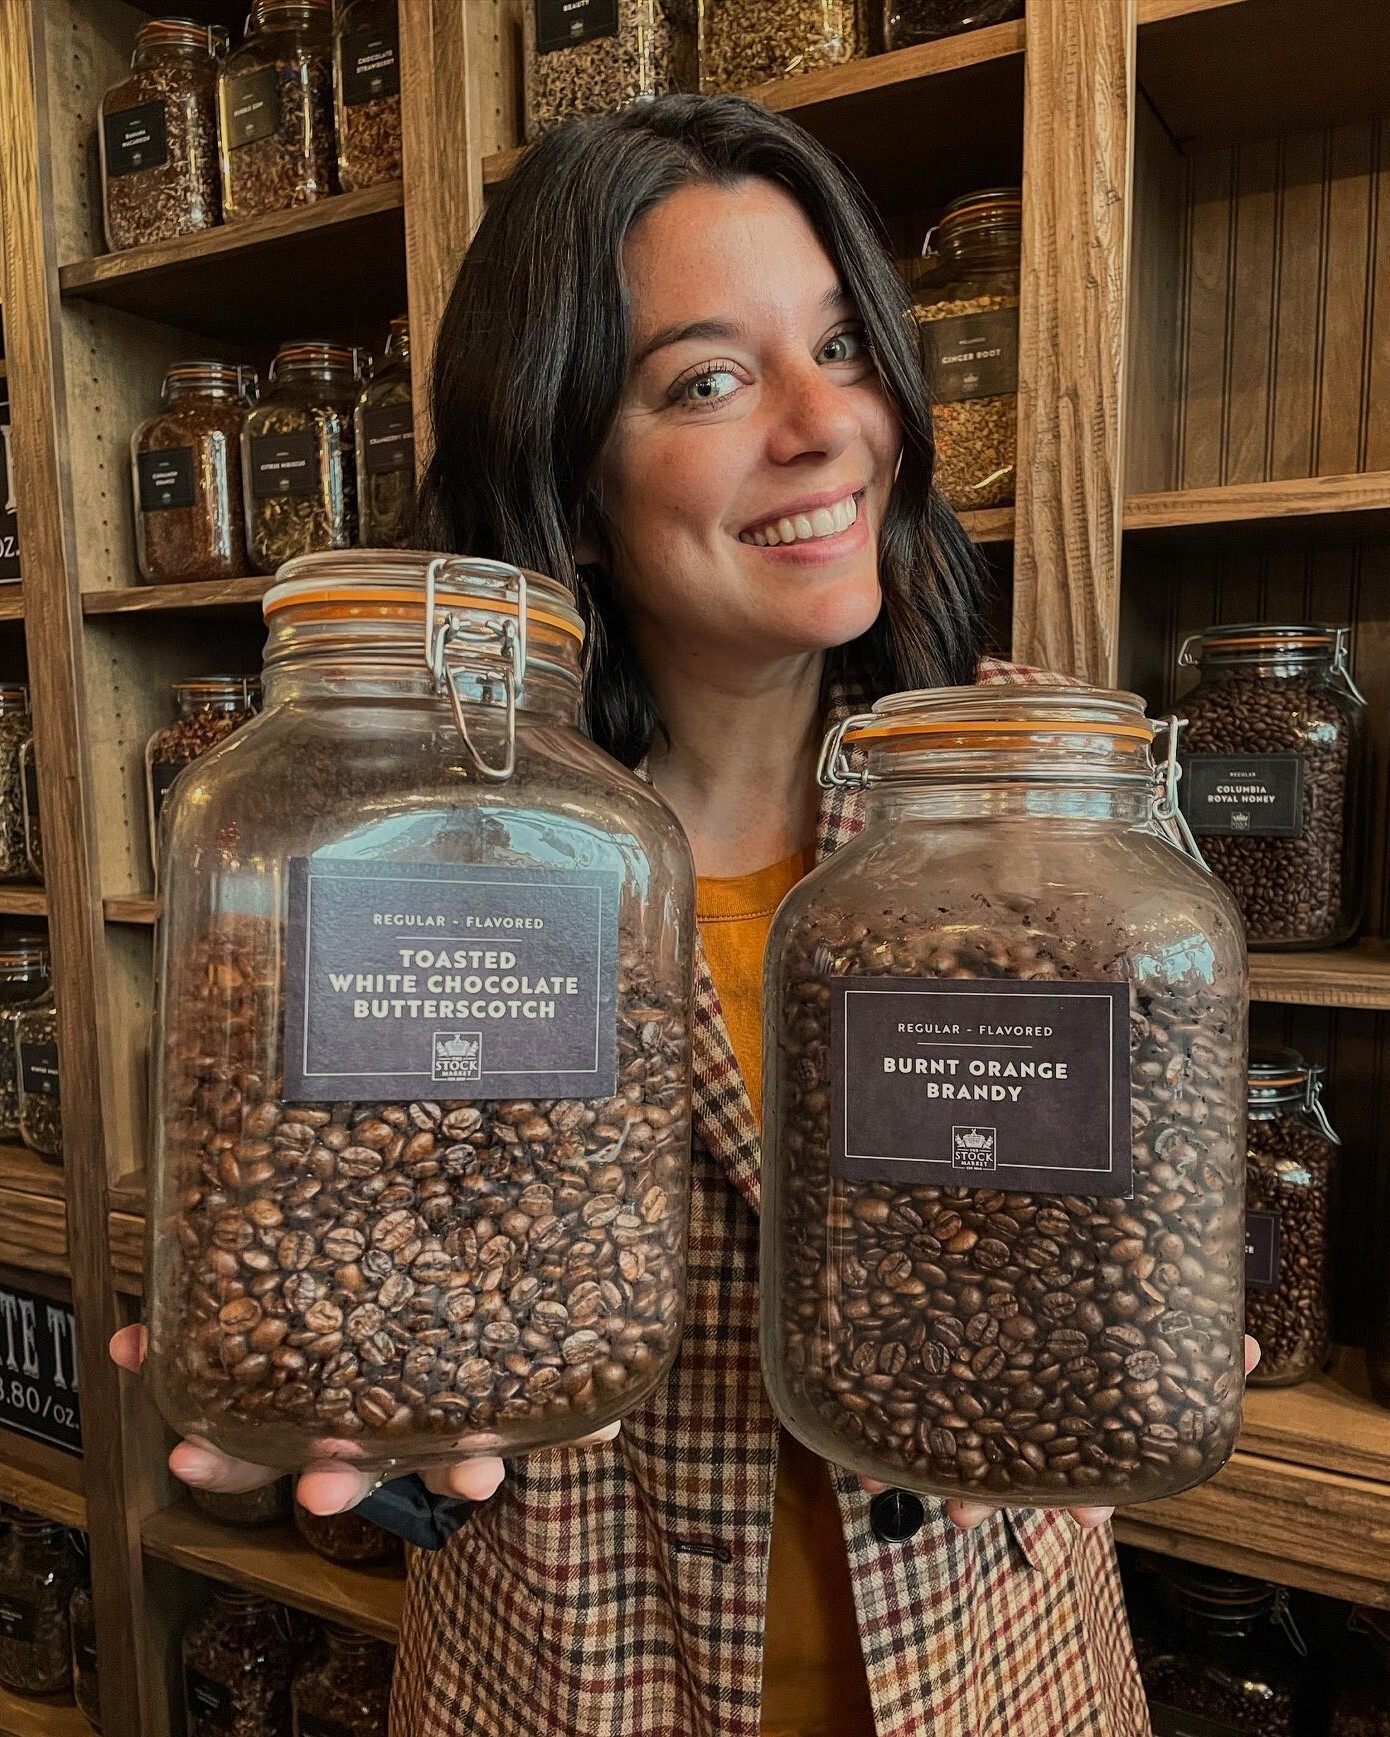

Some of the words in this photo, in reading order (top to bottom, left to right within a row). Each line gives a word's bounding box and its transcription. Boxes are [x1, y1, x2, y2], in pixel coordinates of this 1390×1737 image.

[941, 353, 975, 364] GINGER
[976, 348, 1002, 359] ROOT
[1216, 785, 1267, 794] COLUMBIA
[1207, 794, 1239, 803] ROYAL
[1241, 795, 1276, 804] HONEY
[373, 913, 446, 927] REGULAR
[466, 916, 544, 930] FLAVORED
[398, 950, 517, 970] TOASTED
[328, 974, 418, 993] WHITE
[427, 974, 579, 995] CHOCOLATE
[353, 999, 556, 1019] BUTTERSCOTCH
[898, 1023, 960, 1035] REGULAR
[979, 1025, 1054, 1037] FLAVORED
[435, 1060, 478, 1071] STOCK
[883, 1057, 960, 1076] BURNT
[968, 1060, 1068, 1079] ORANGE
[926, 1083, 1023, 1102] BRANDY
[955, 1151, 994, 1162] STOCK
[0, 1291, 40, 1379] TE
